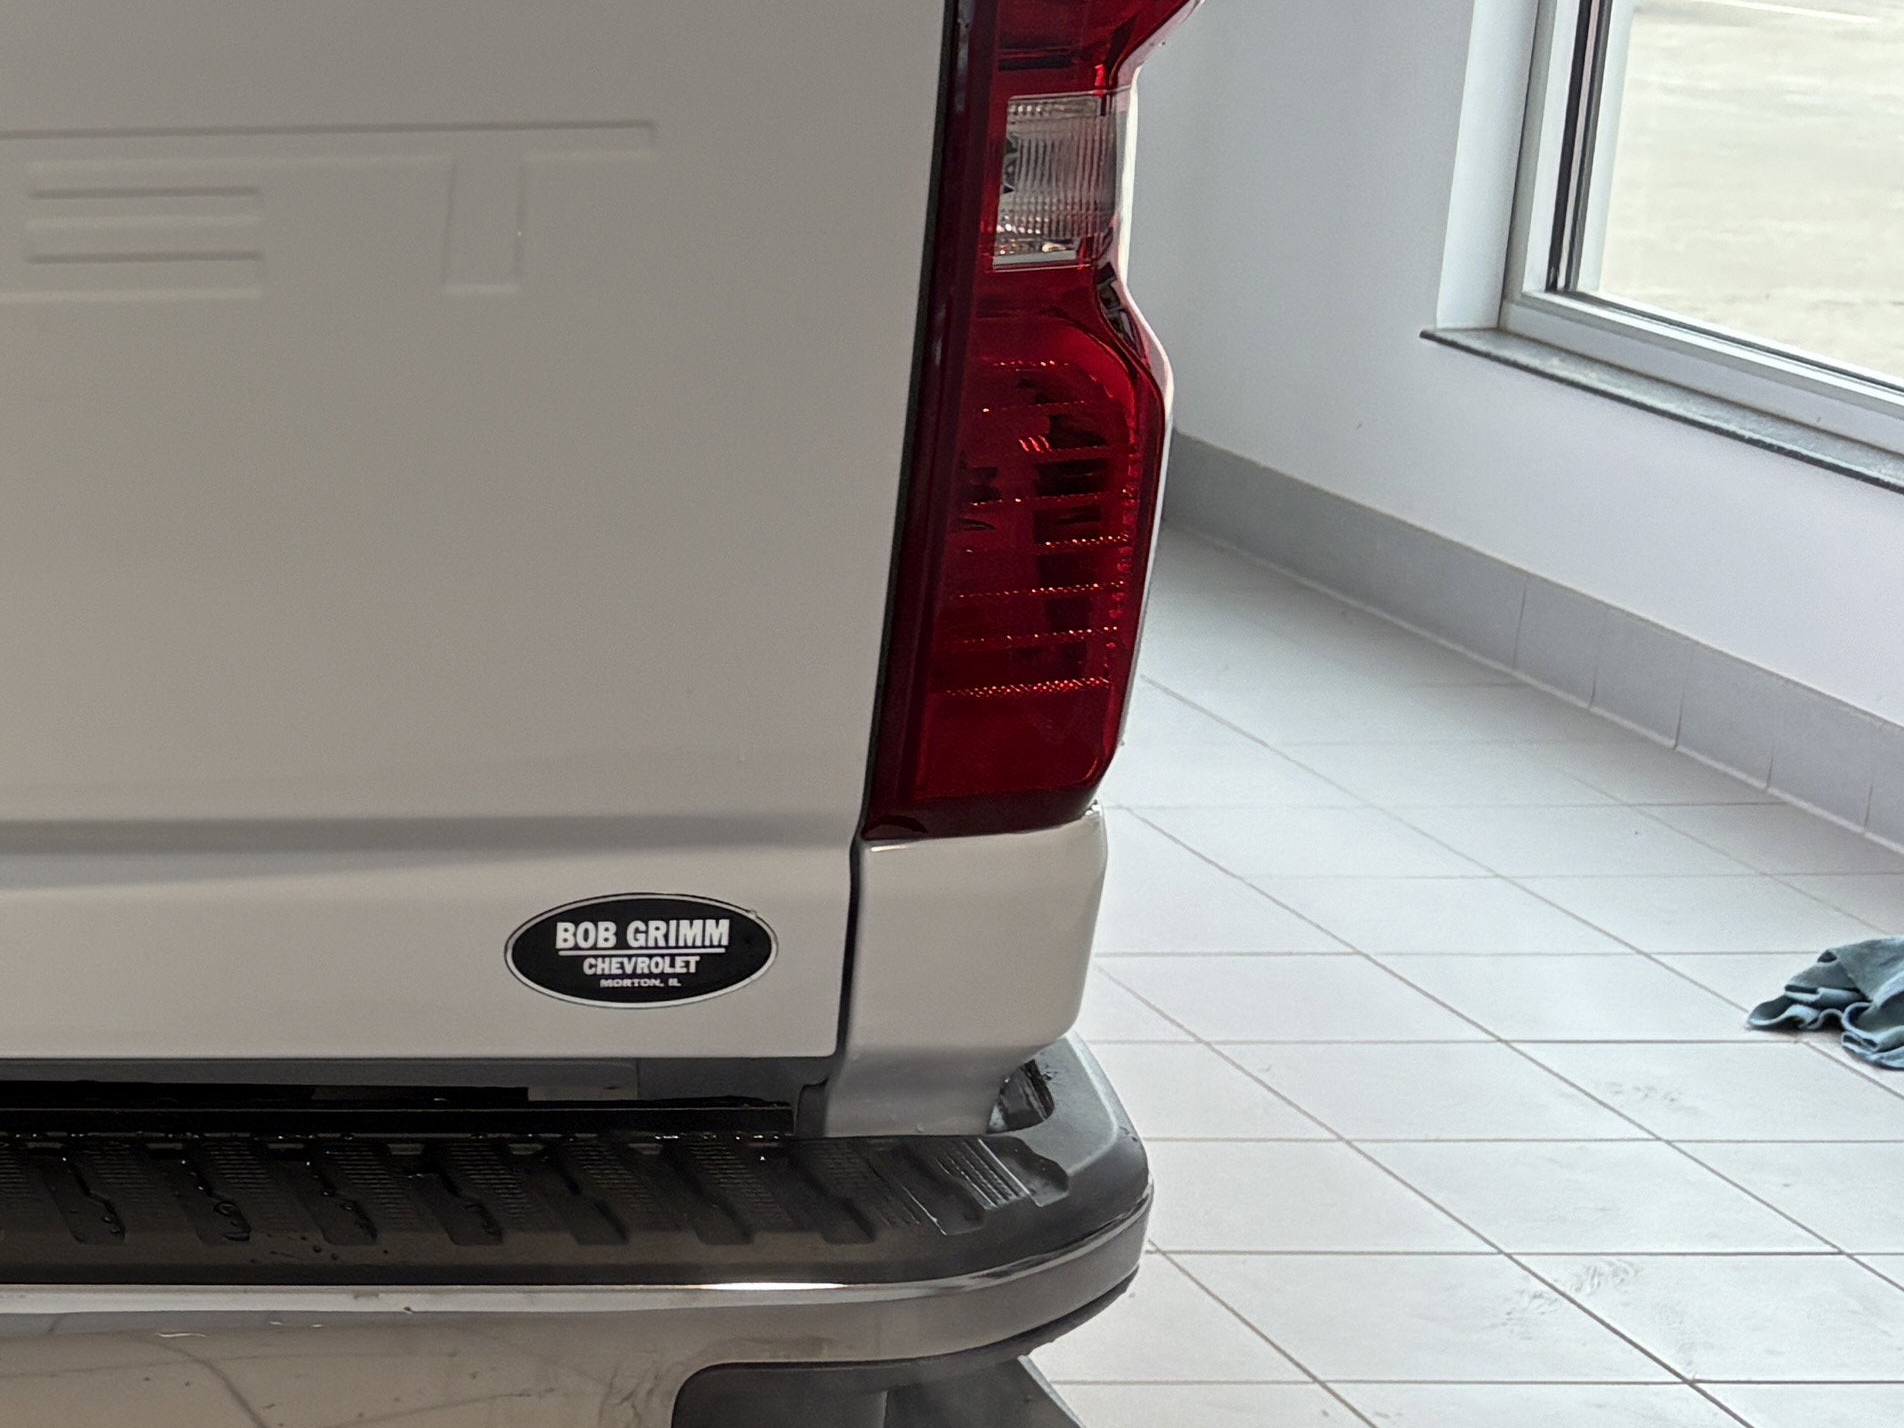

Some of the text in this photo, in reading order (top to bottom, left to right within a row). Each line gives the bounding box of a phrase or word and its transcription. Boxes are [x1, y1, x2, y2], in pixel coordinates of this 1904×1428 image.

[555, 918, 730, 949] BOB GRIMM
[582, 956, 701, 976] CHEVROLET
